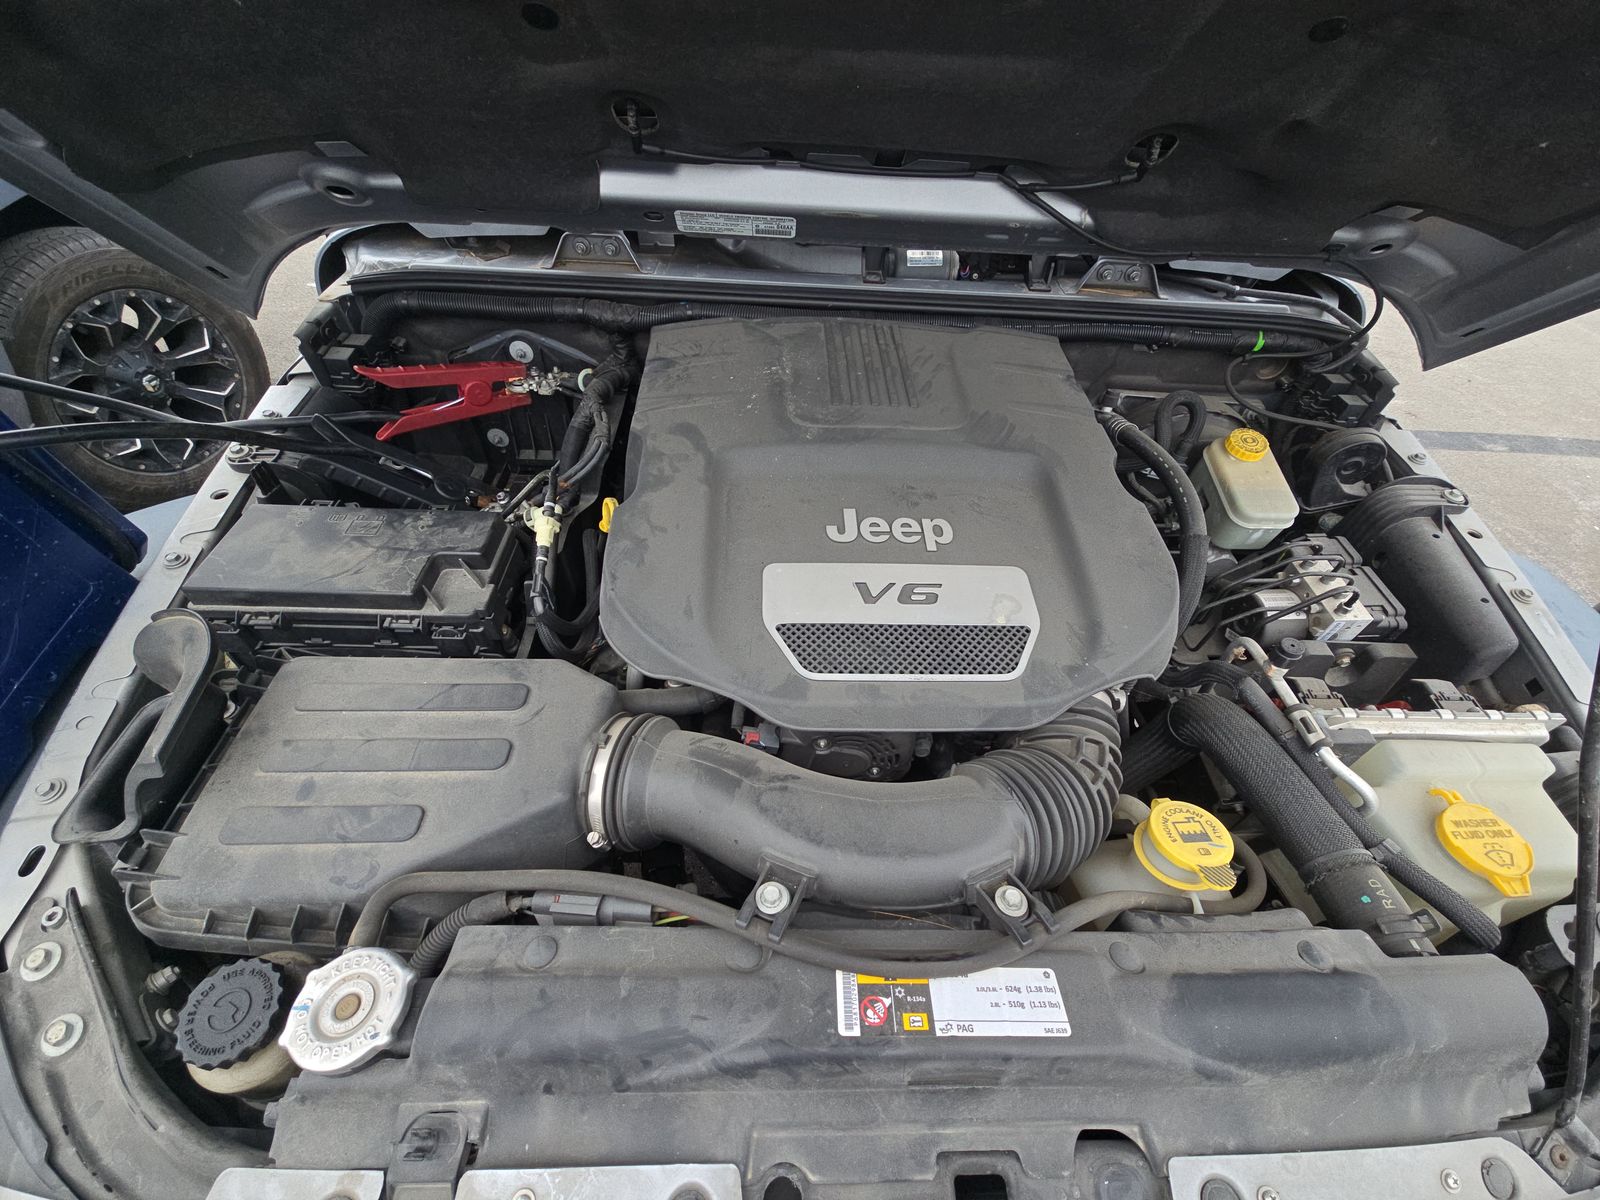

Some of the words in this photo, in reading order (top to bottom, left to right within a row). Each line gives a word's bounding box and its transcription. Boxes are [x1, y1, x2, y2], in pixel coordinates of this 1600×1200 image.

[825, 508, 954, 552] Jeep
[854, 582, 943, 605] V6
[1165, 807, 1204, 819] COOLANT
[1451, 818, 1502, 829] WASHER
[1161, 815, 1178, 844] ENGINE
[1205, 819, 1223, 840] ONLY
[1450, 830, 1485, 840] FLUID
[1485, 829, 1514, 839] ONLY
[1368, 879, 1397, 909] RAD
[331, 956, 371, 978] KEEP
[372, 957, 397, 989] TIGHT
[222, 967, 246, 981] USE
[248, 967, 274, 1011] APPROVED
[1005, 985, 1022, 994] 624g
[1025, 985, 1043, 995] (1.38
[1044, 985, 1057, 995] lbs)
[185, 983, 216, 1026] POWER
[1008, 1001, 1026, 1010] 510g
[1029, 1001, 1047, 1010] (1.13
[1048, 1001, 1061, 1010] lbs)
[184, 1028, 227, 1056] STEERING
[230, 1020, 262, 1050] FLUID
[295, 1023, 318, 1050] NOT
[311, 1042, 353, 1061] OPEN
[355, 1016, 384, 1046] HOT
[956, 1024, 975, 1033] PAG
